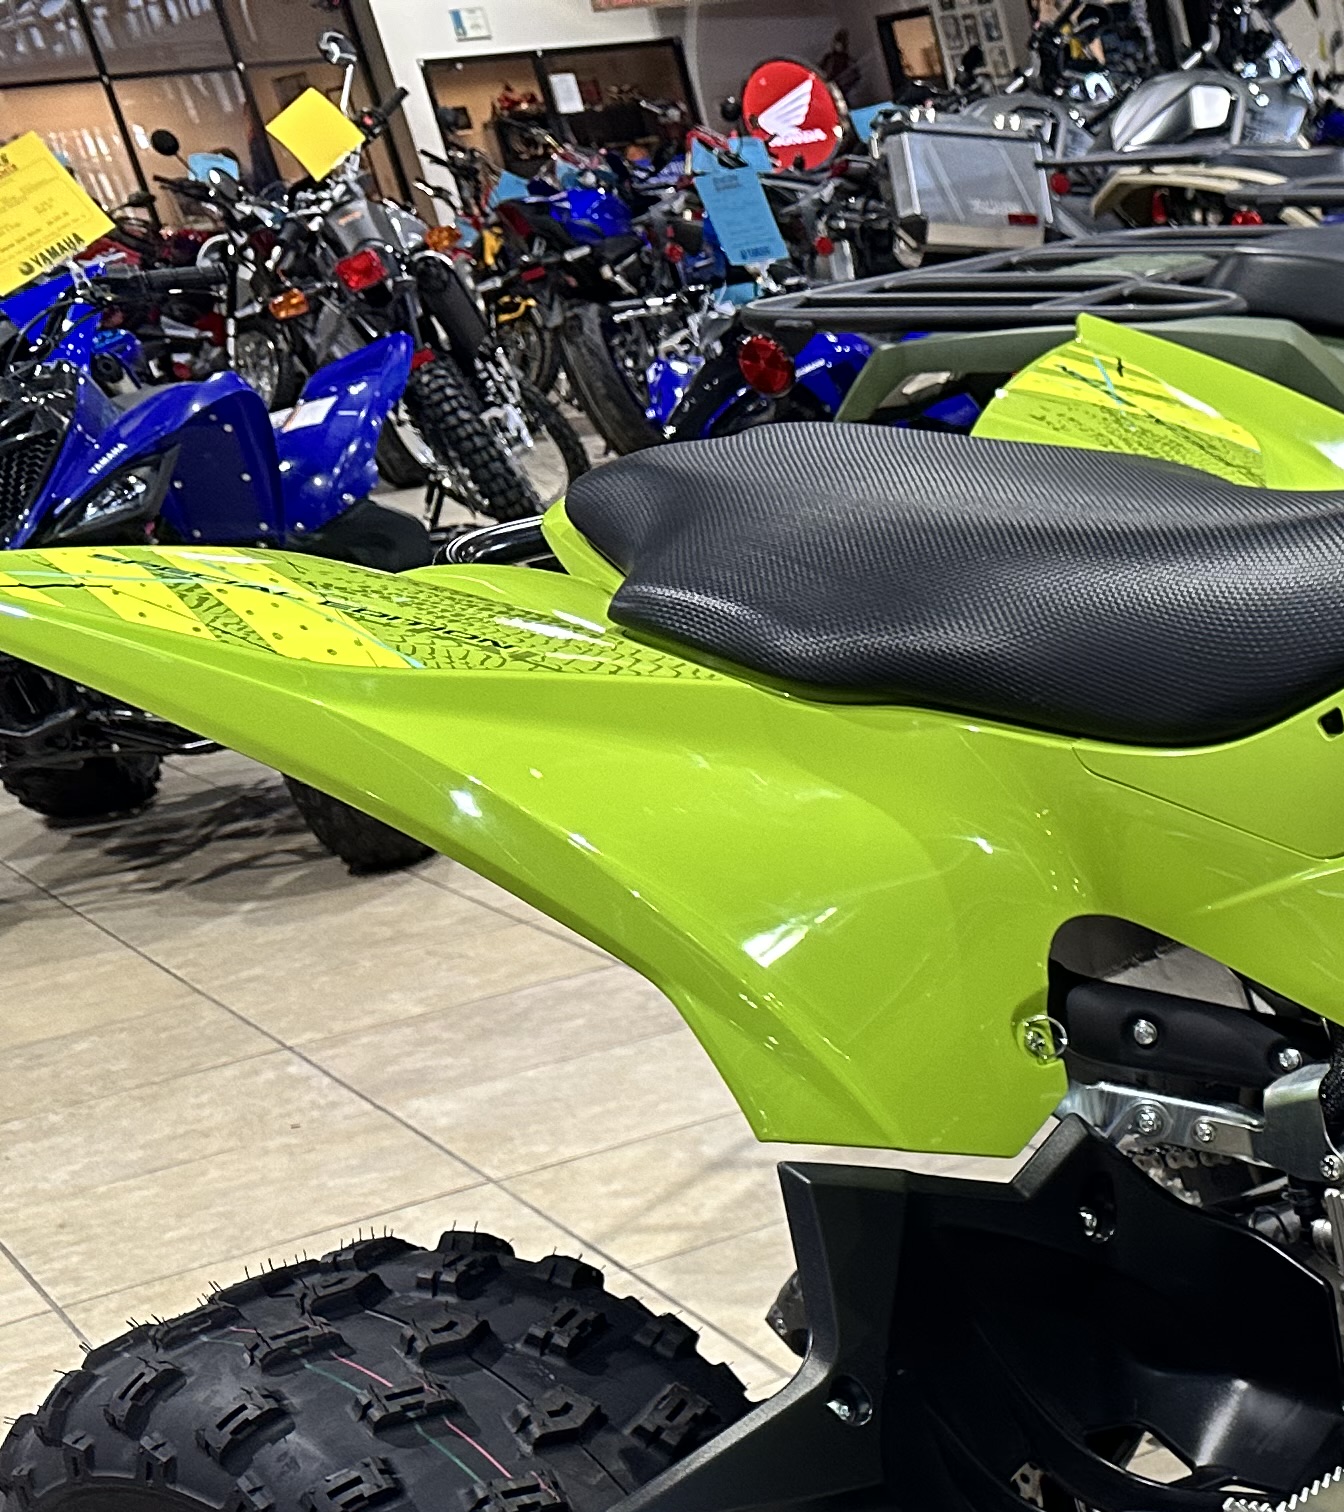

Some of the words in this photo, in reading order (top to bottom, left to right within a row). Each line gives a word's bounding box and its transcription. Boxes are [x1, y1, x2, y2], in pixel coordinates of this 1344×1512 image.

[30, 232, 86, 269] YAMAHA
[89, 552, 306, 602] SPECIAL
[317, 599, 519, 650] EDITION
